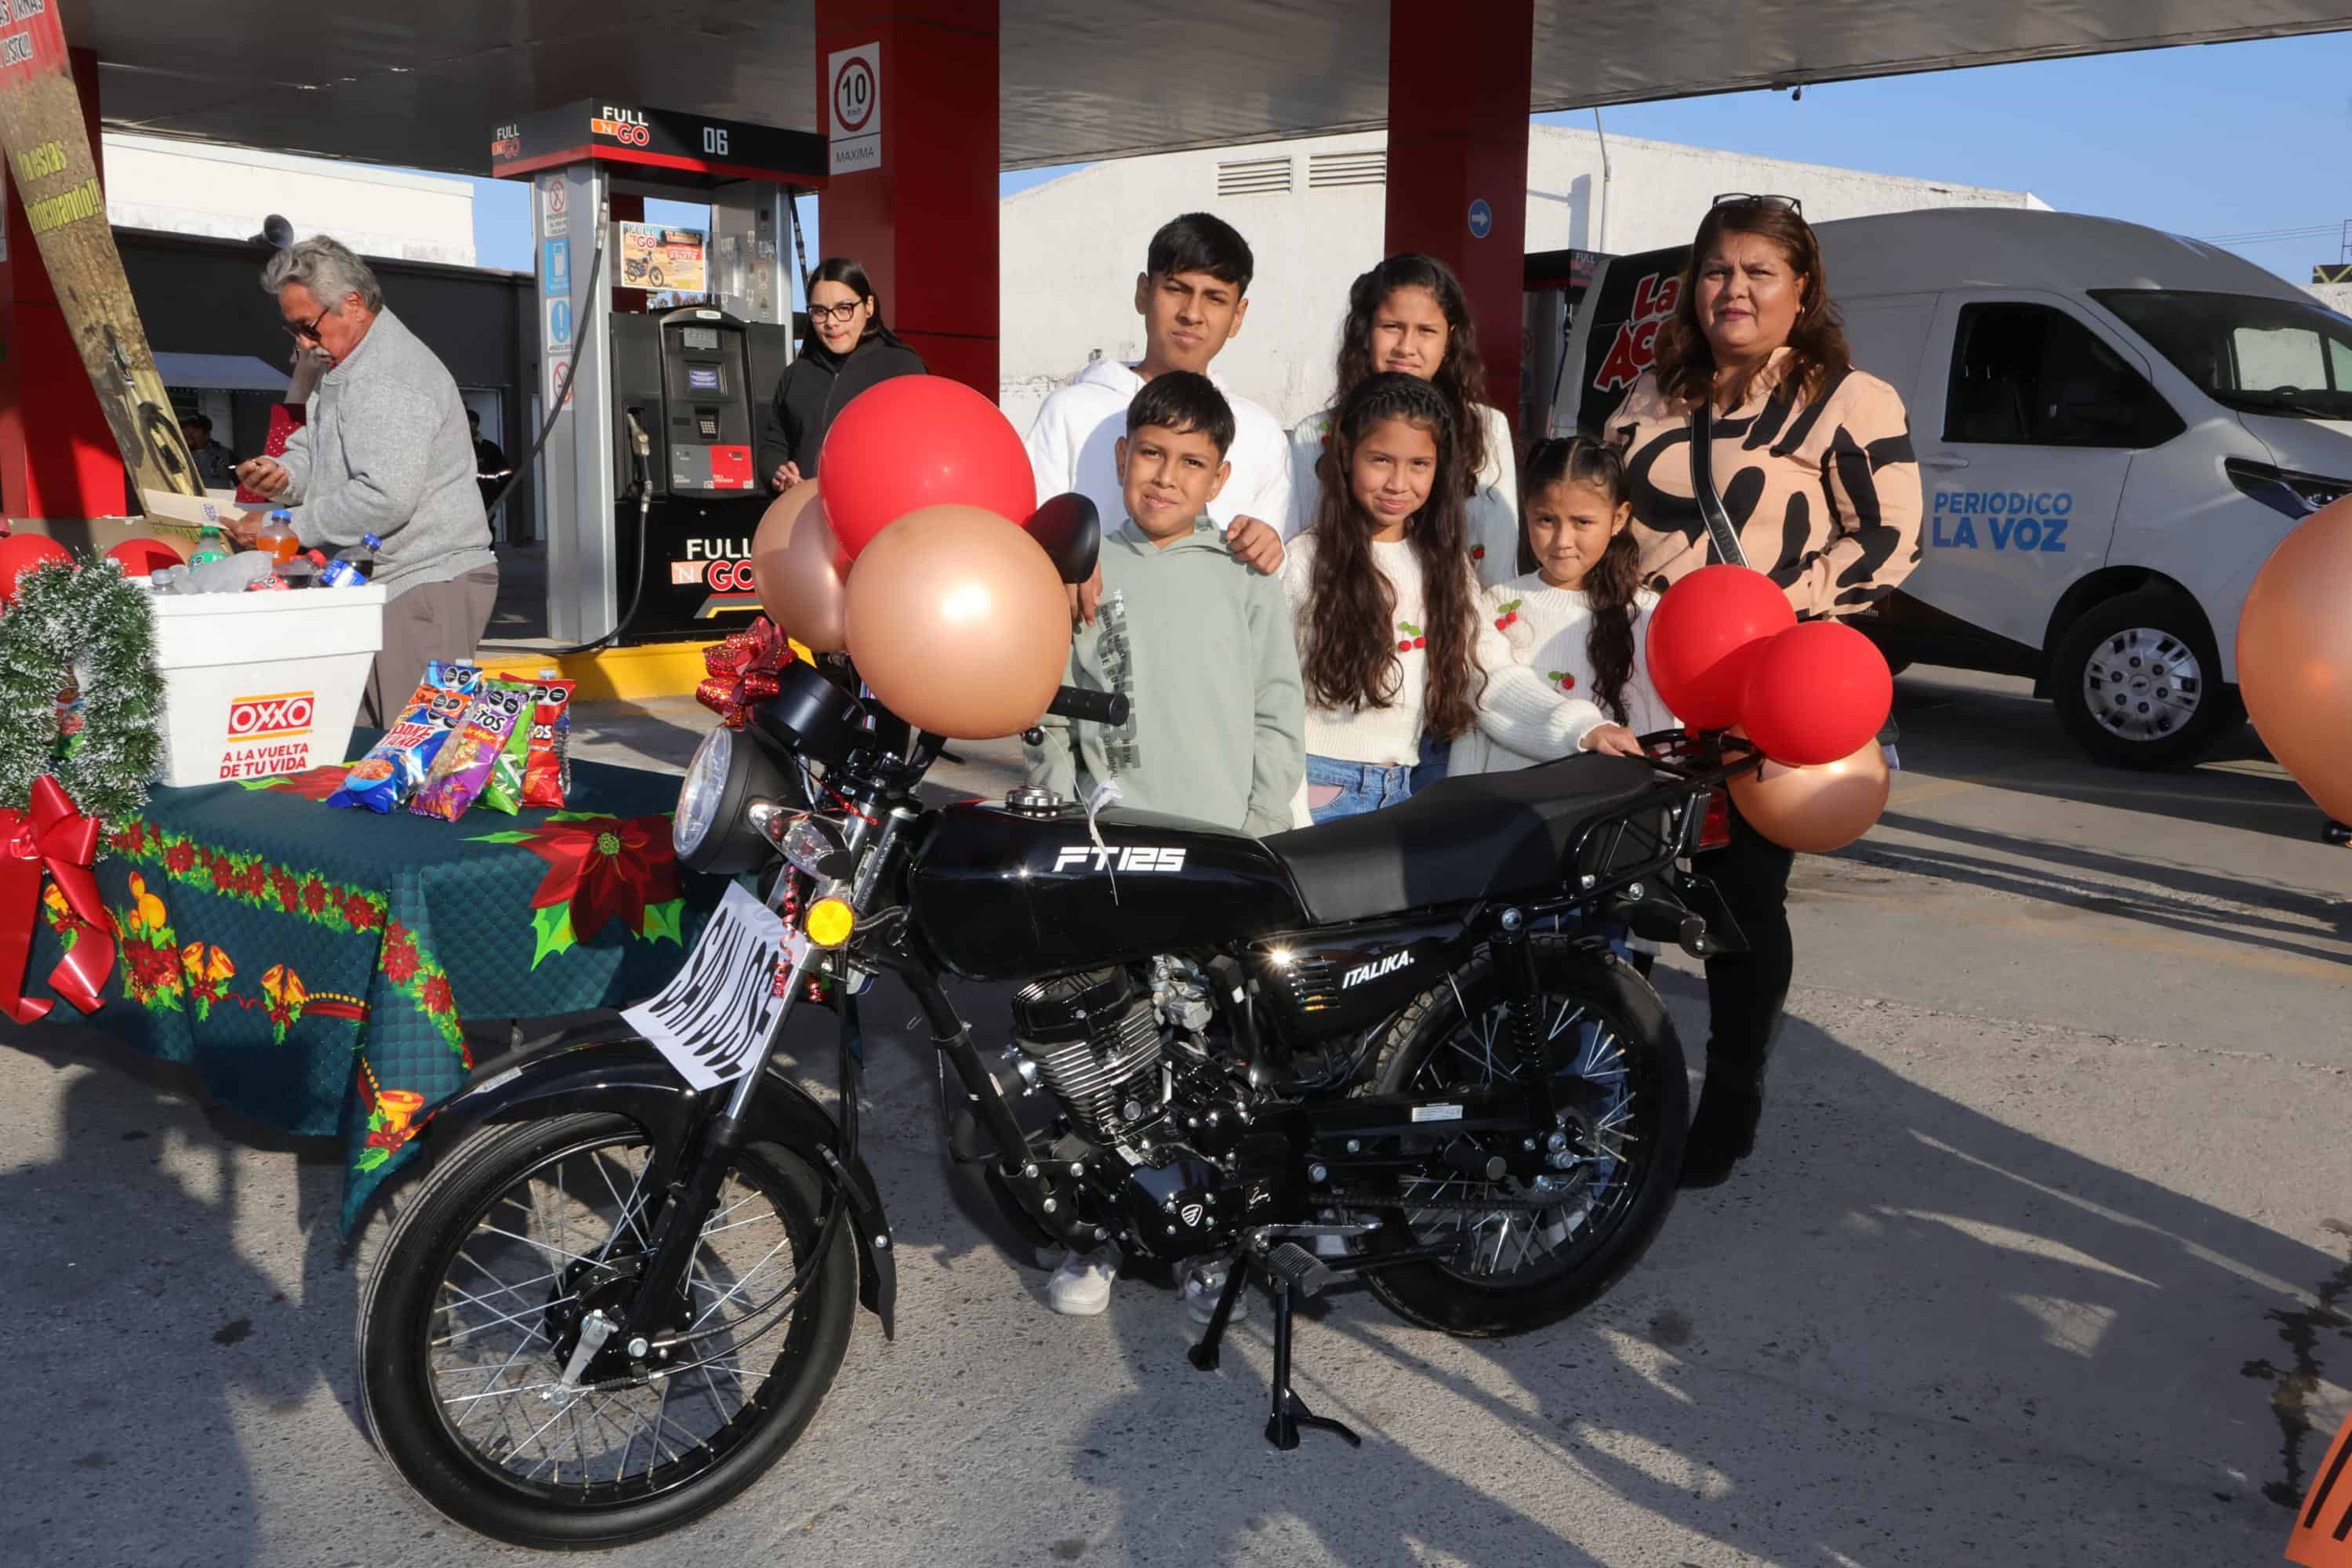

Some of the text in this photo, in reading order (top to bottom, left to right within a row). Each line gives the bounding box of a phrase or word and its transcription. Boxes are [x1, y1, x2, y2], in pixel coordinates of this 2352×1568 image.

[842, 74, 866, 107] 10
[603, 107, 649, 127] FULL
[496, 123, 520, 141] FULL
[617, 123, 650, 147] GO
[703, 127, 729, 156] 06
[836, 147, 875, 164] MAXIMA
[1632, 273, 1682, 325] La
[1933, 491, 2073, 516] PERIODICO
[1932, 516, 2070, 553] LA VOZ
[686, 538, 753, 560] FULL
[708, 559, 754, 592] GO
[231, 698, 312, 733] OXXO
[222, 742, 309, 763] A LA VUELTA
[220, 756, 307, 779] DE TU VIDA
[1341, 949, 1410, 989] ITALIKA
[648, 906, 793, 1080] SAN JOSE
